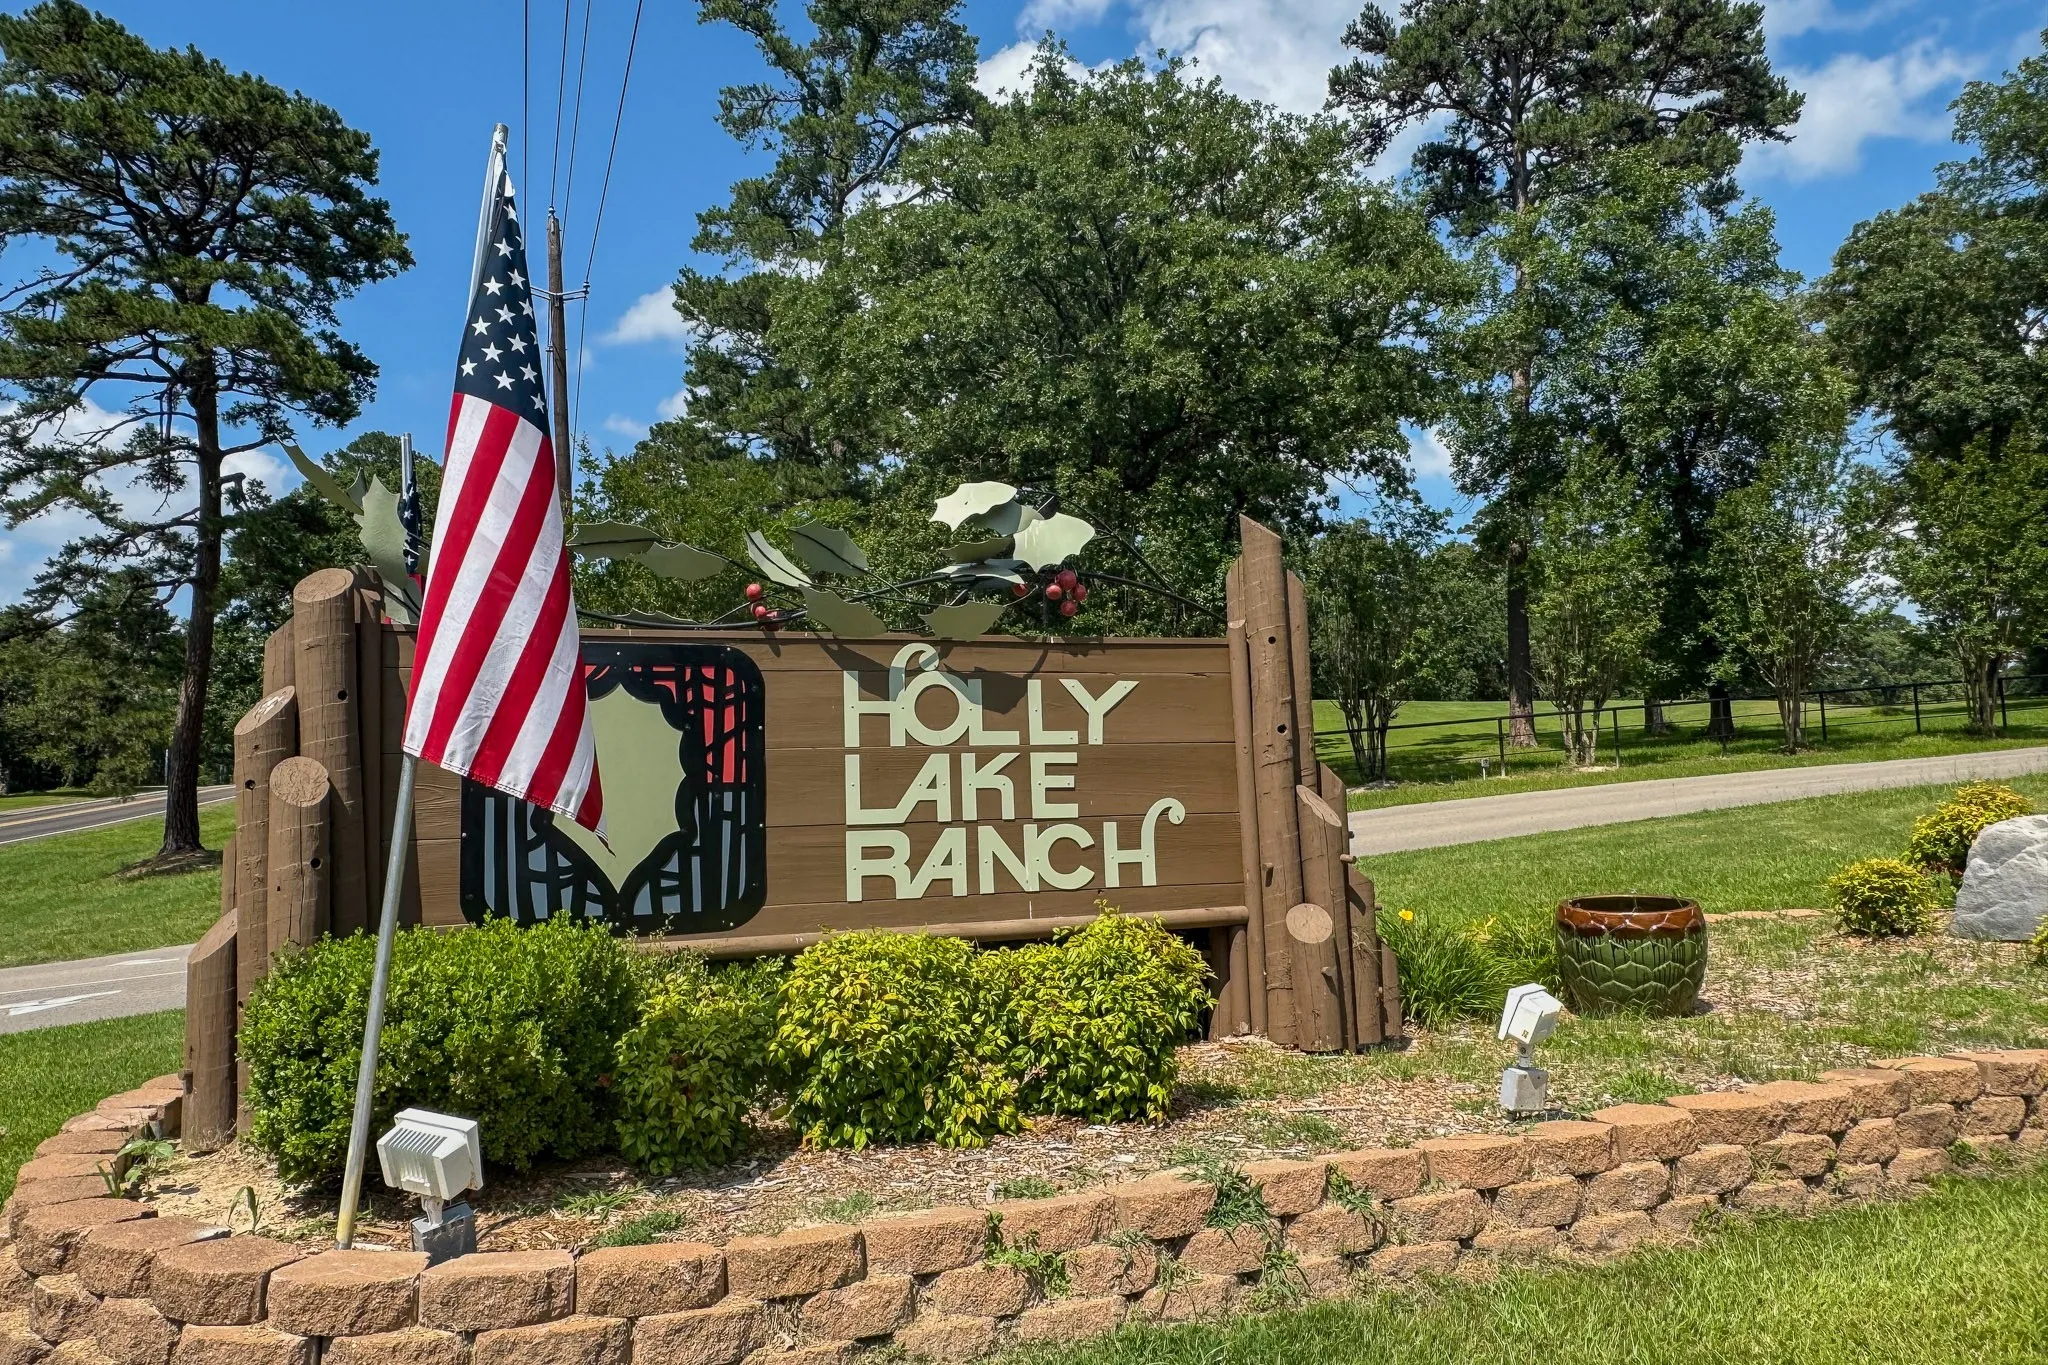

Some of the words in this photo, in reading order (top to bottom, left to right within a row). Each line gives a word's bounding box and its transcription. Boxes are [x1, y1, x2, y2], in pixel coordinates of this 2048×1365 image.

[843, 643, 1140, 747] HOLLY
[844, 752, 1079, 826] LAKE
[845, 797, 1186, 902] RANCH
